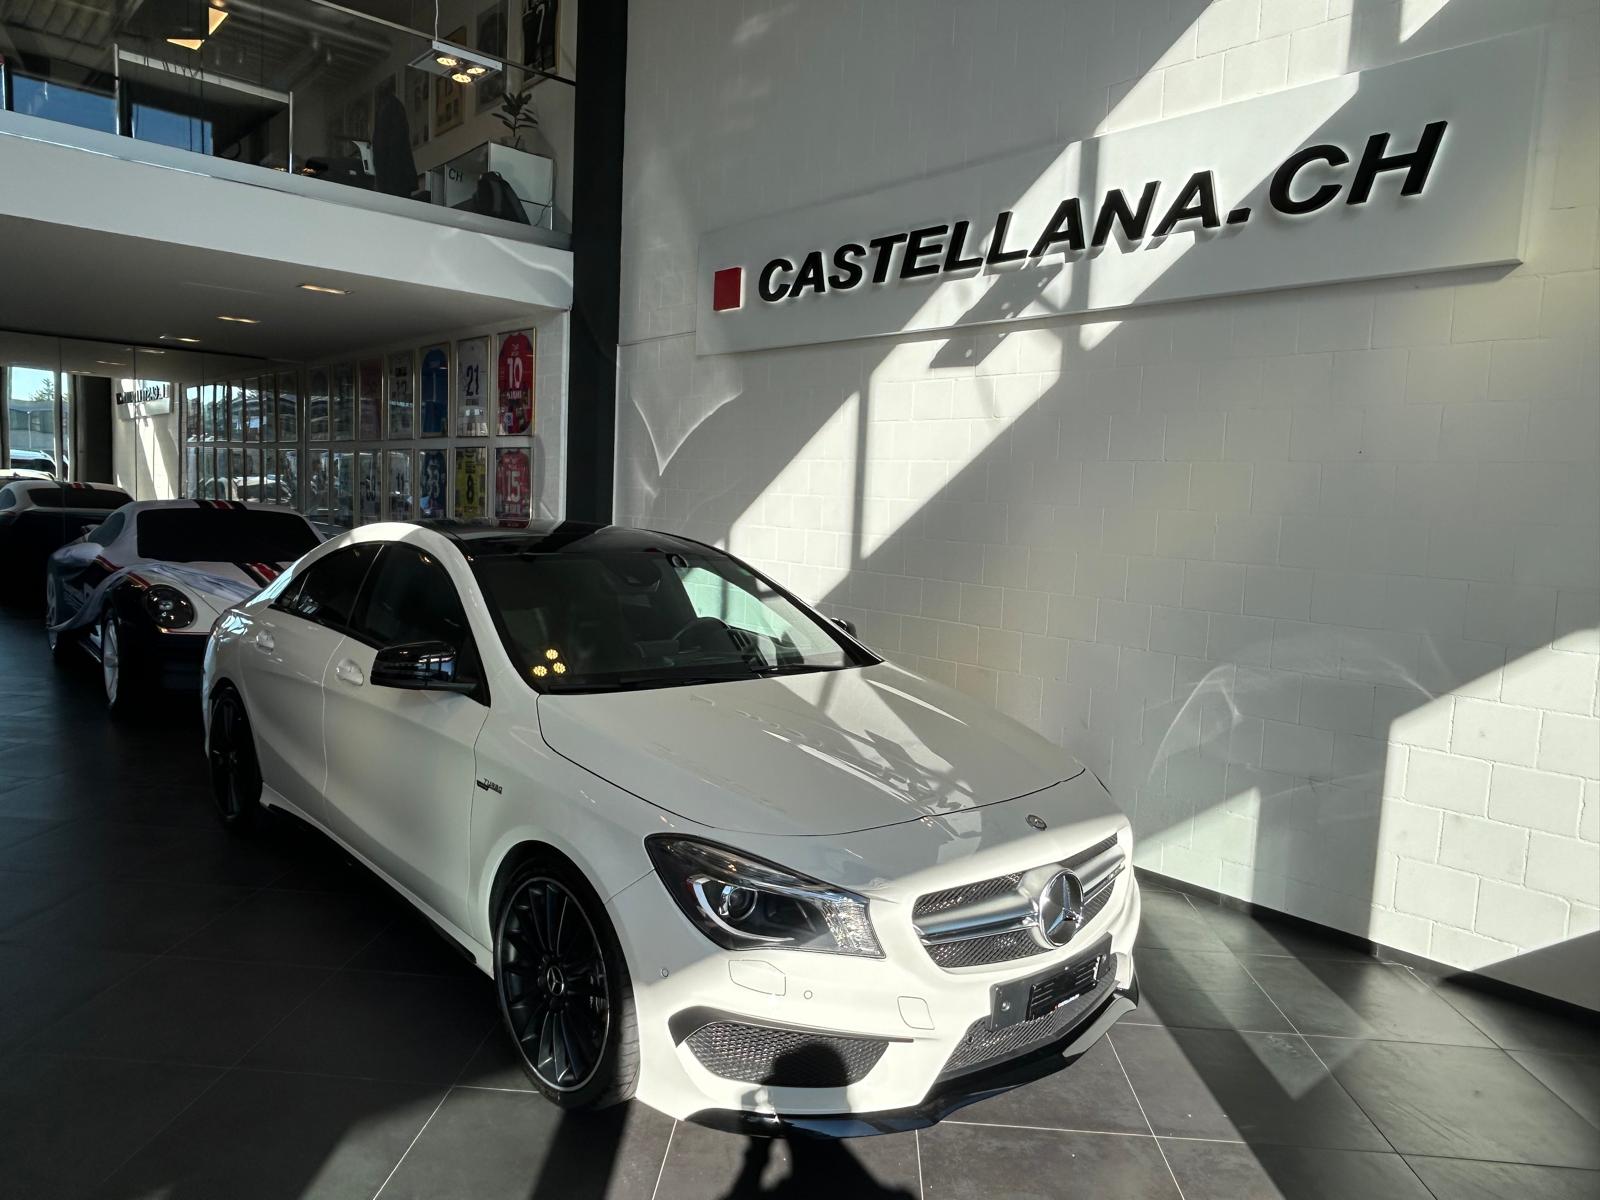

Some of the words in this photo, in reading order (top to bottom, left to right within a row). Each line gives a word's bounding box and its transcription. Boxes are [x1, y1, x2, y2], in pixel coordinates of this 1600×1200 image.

[448, 168, 464, 183] CH
[466, 364, 479, 397] 21
[507, 356, 523, 389] 10
[466, 474, 474, 504] 8
[507, 470, 521, 503] 15
